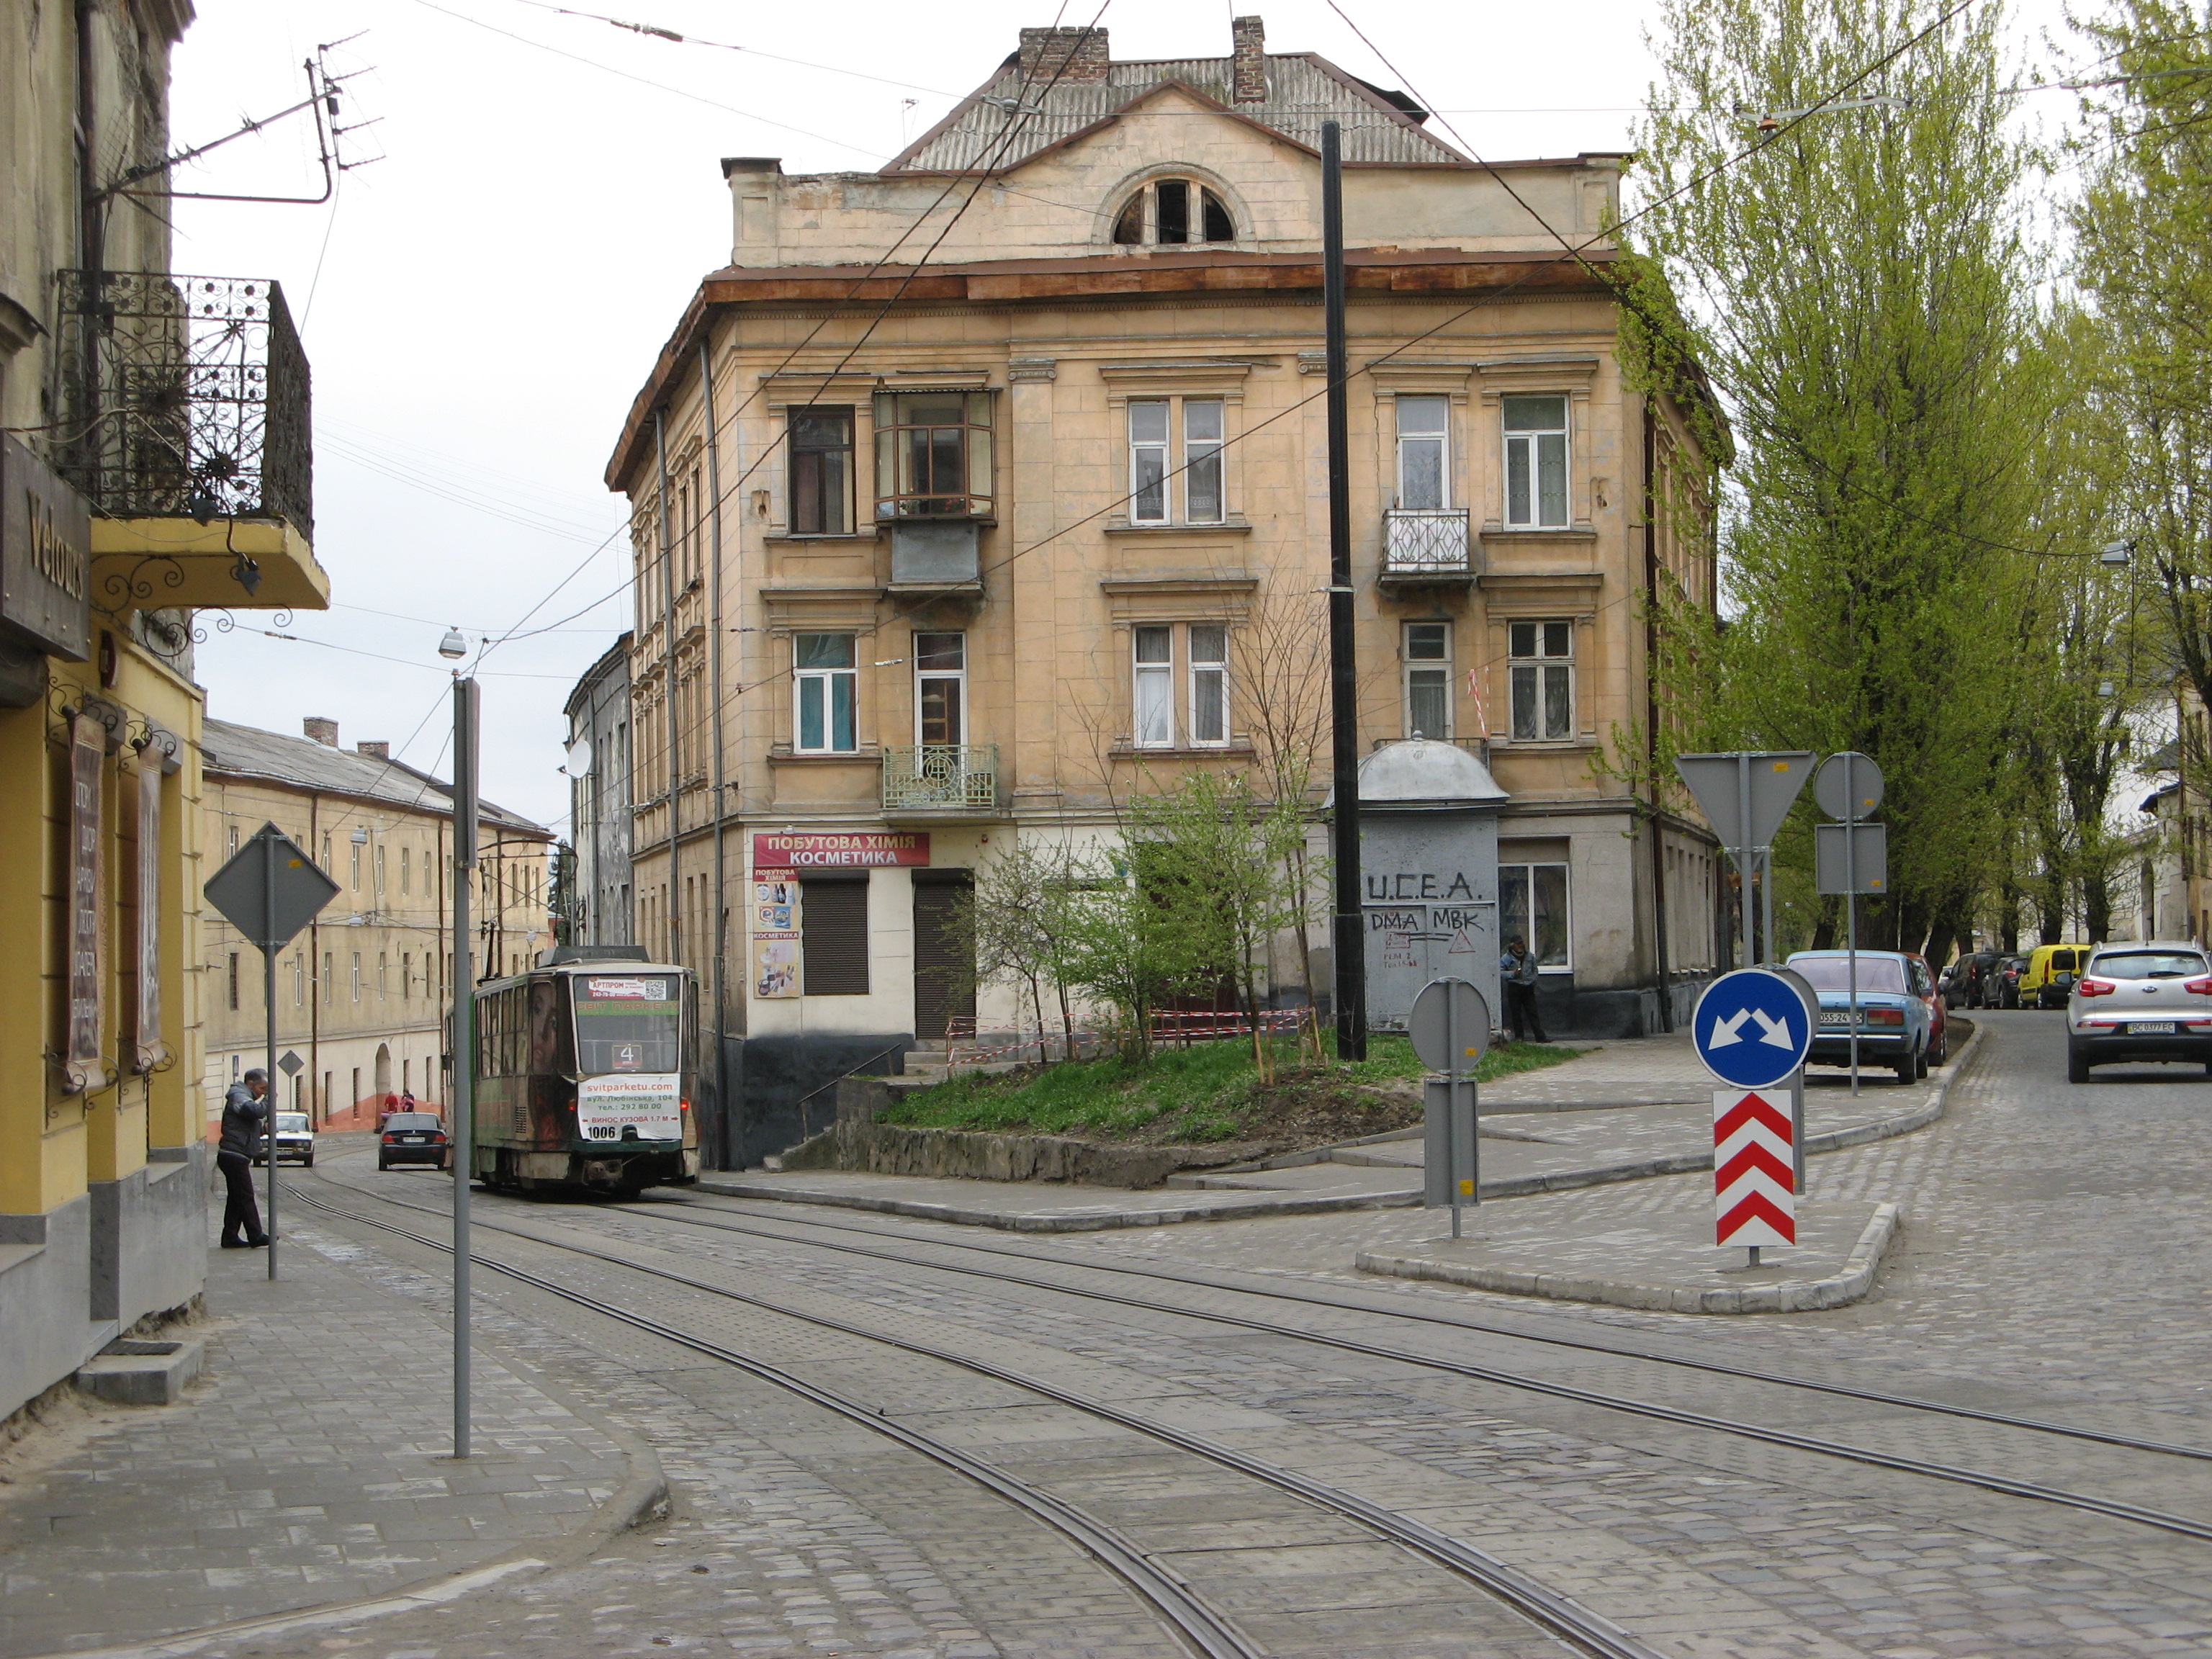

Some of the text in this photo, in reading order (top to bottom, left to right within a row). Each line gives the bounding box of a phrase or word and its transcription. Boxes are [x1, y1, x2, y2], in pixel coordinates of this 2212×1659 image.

[26, 485, 84, 601] Velours
[768, 835, 916, 850] ПОБУТОВА ХІМІЯ
[789, 851, 899, 865] КОСМЕТИКА
[1372, 912, 1419, 931] DMA
[1434, 908, 1485, 932] MBK
[621, 1046, 634, 1061] 4
[587, 1083, 673, 1092] svitparketu.com
[588, 1126, 616, 1139] 1006
